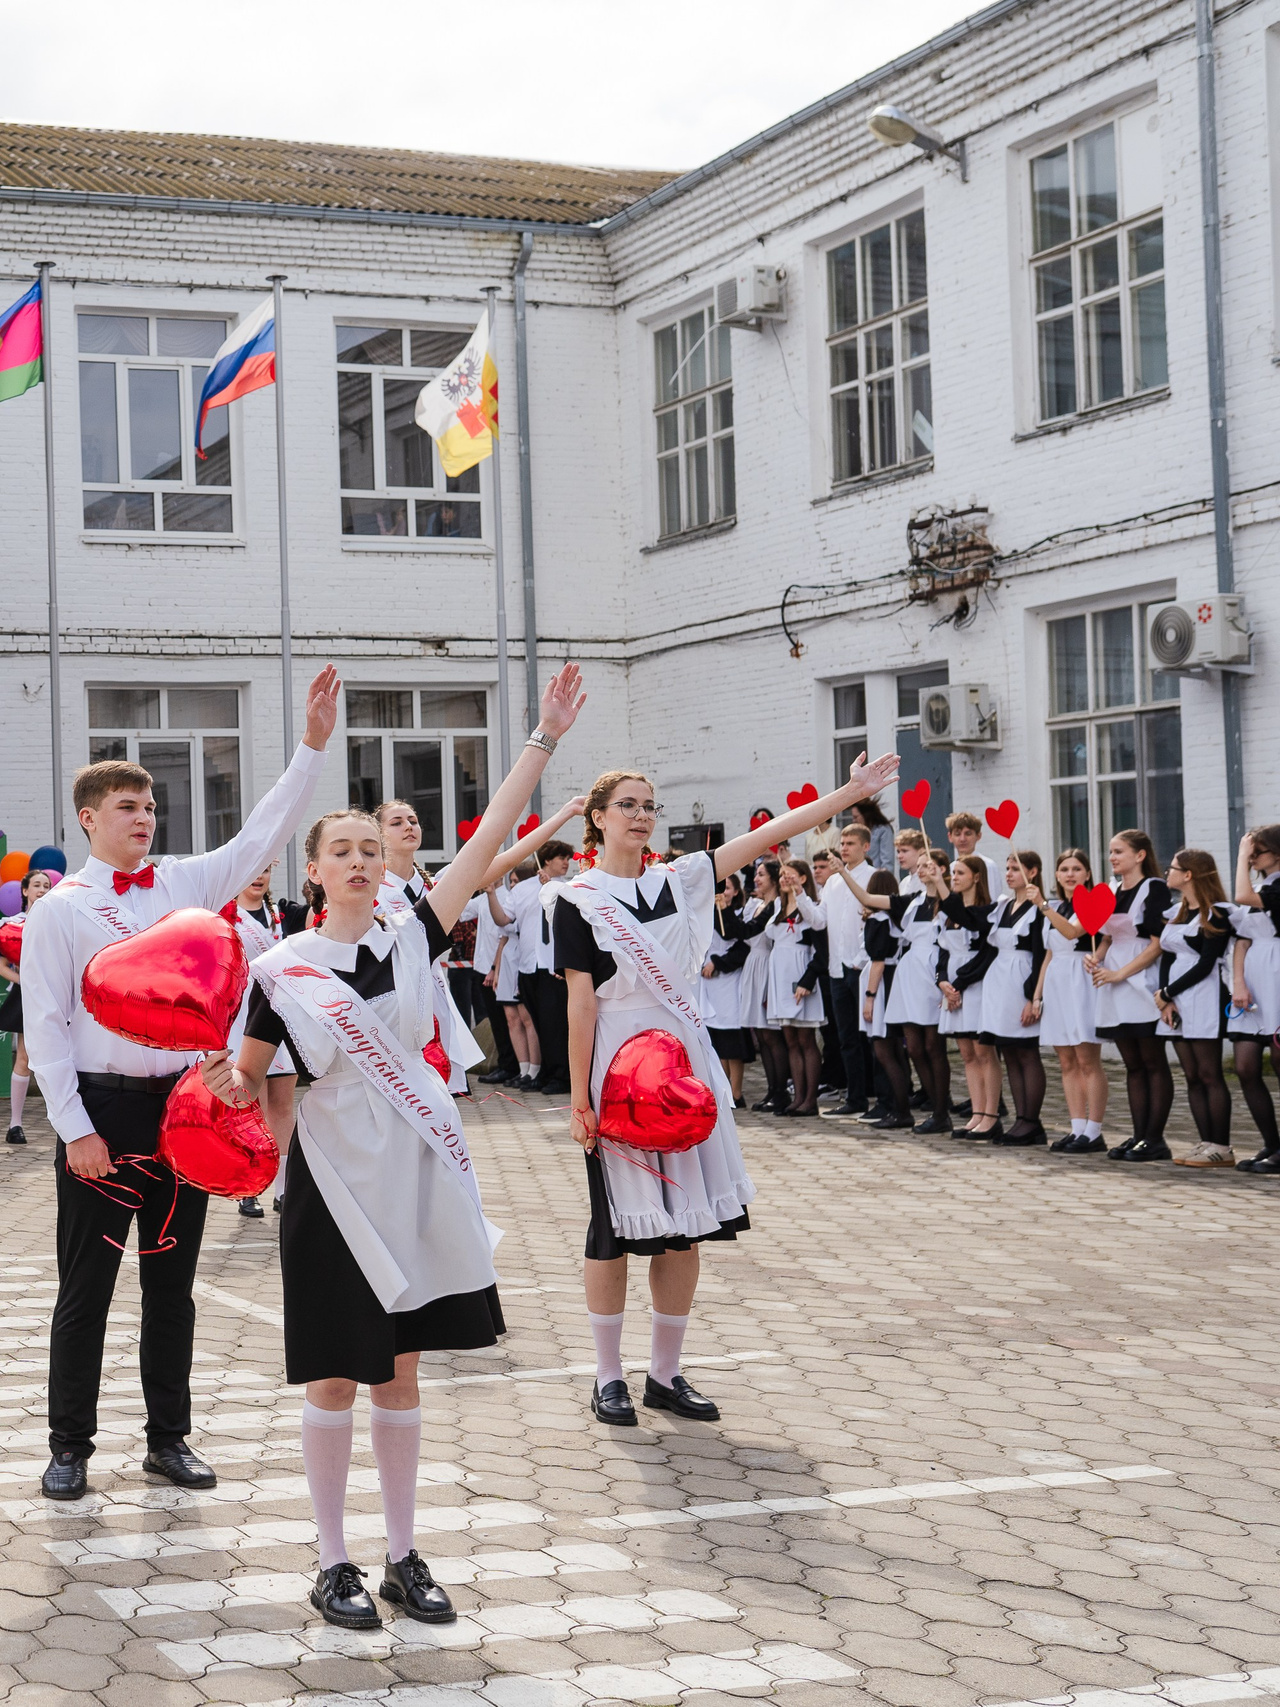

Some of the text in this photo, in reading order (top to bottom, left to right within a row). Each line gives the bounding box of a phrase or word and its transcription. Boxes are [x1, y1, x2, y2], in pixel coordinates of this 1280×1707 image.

[587, 893, 703, 1029] Выпускница 2026
[312, 983, 472, 1173] Выпускница 2026
[369, 1026, 406, 1074] Денисова Софья
[388, 1093, 406, 1108] №75
